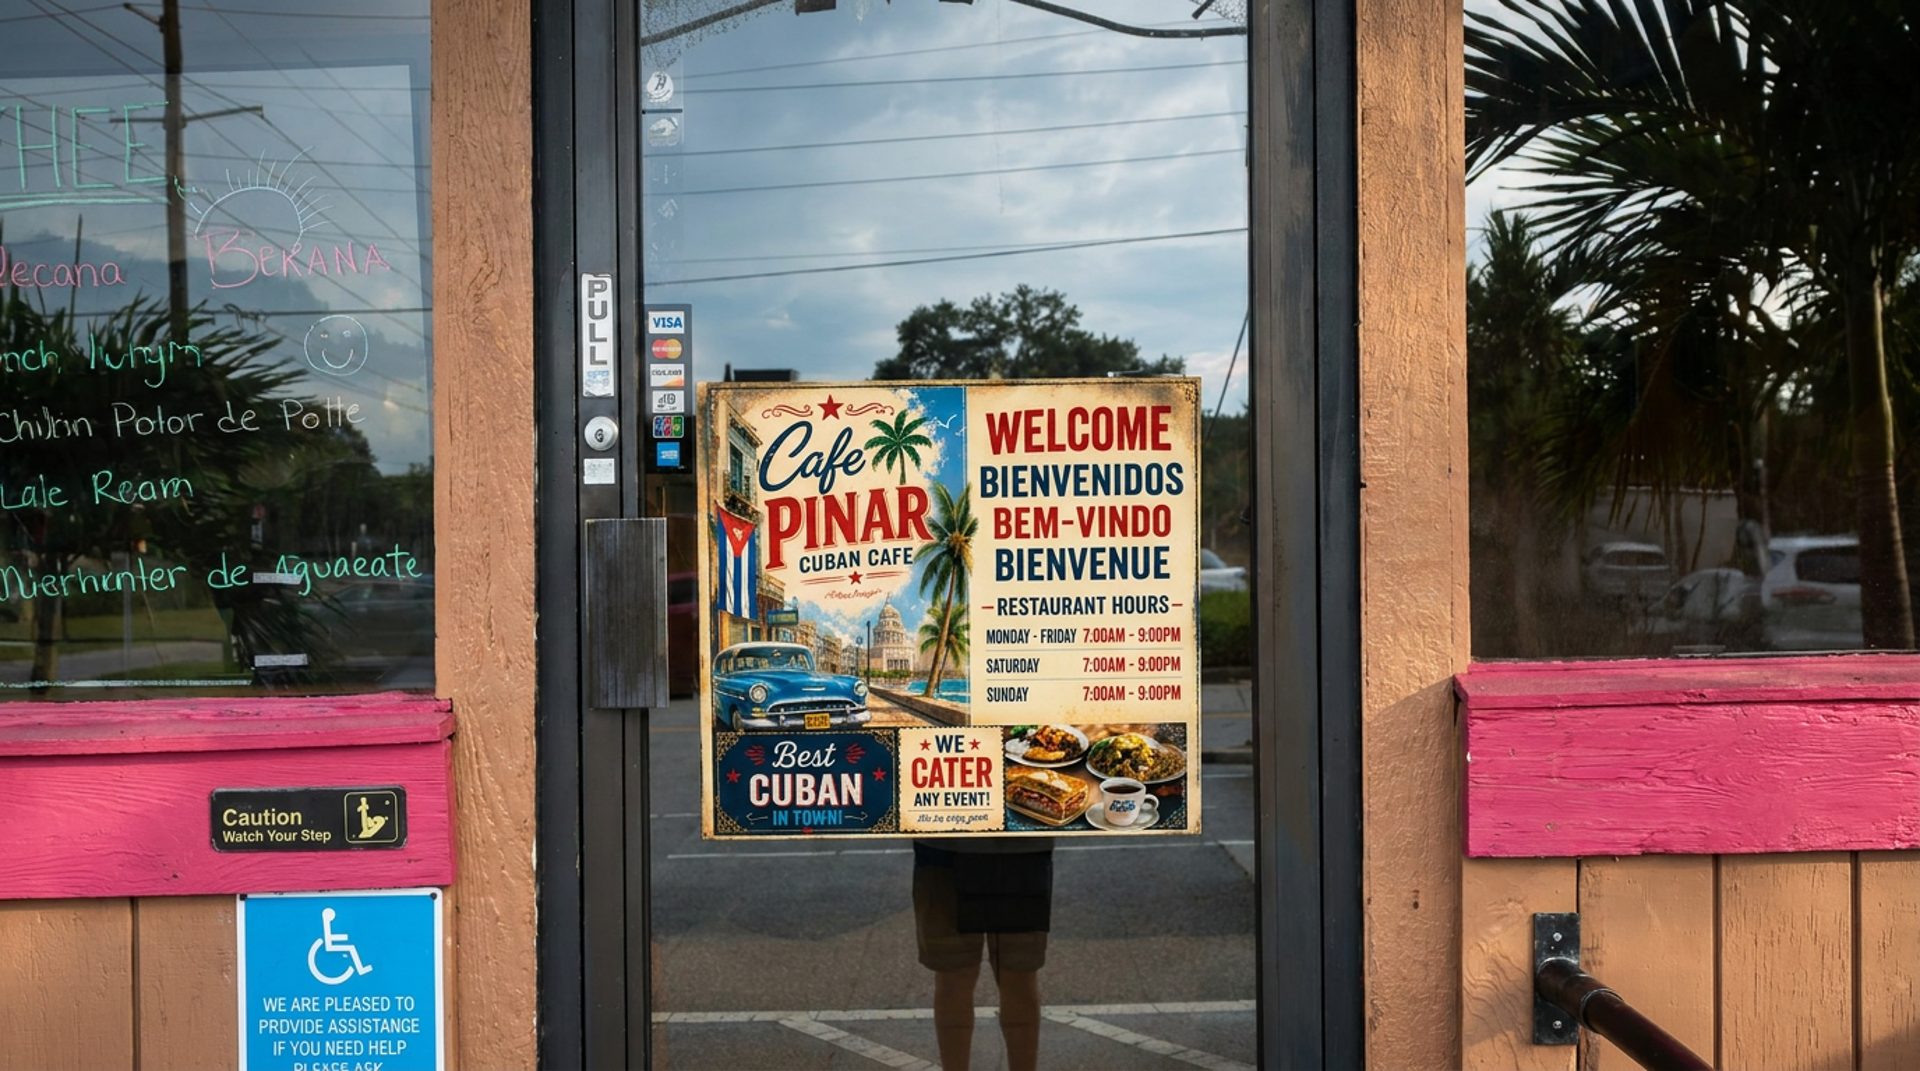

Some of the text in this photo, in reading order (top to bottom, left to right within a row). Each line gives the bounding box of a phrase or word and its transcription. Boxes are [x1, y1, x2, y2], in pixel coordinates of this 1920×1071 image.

[0, 101, 169, 190] HEE
[588, 281, 607, 366] PULL
[653, 317, 682, 328] VISA
[218, 401, 259, 433] de
[986, 405, 1172, 455] WELCOME
[759, 420, 866, 494] Cafe
[980, 462, 1184, 498] BIENVENIDOS
[764, 486, 938, 571] PINAR
[994, 504, 1172, 540] BEM-VINDO
[207, 552, 250, 588] de
[800, 547, 913, 573] CUBAN CAFE
[995, 546, 1170, 582] BIENVENUE
[997, 595, 1169, 616] RESTAURANT HOURS
[986, 629, 1030, 644] MONDAY
[1040, 628, 1077, 644] FRIDAY
[1083, 627, 1126, 643] 7:00AM
[1138, 627, 1181, 643] 9:00PM
[986, 658, 1040, 674] SATURDAY
[1083, 657, 1126, 673] 7:00AM
[1138, 656, 1181, 672] 9:00PM
[986, 686, 1029, 702] SUNDAY
[1083, 686, 1126, 701] 7:00AM
[1138, 685, 1181, 701] 9:00PM
[772, 741, 836, 769] Best
[935, 735, 965, 753] WE
[911, 757, 993, 788] CATER
[748, 773, 863, 807] CUBAN
[914, 792, 990, 806] ANY EVENT!
[222, 808, 302, 827] Caution
[772, 810, 788, 826] IN
[222, 830, 331, 844] Watch Your Step
[263, 996, 415, 1012] WE ARE PLEASED TO
[273, 1040, 407, 1056] IF YOU NEED HELP
